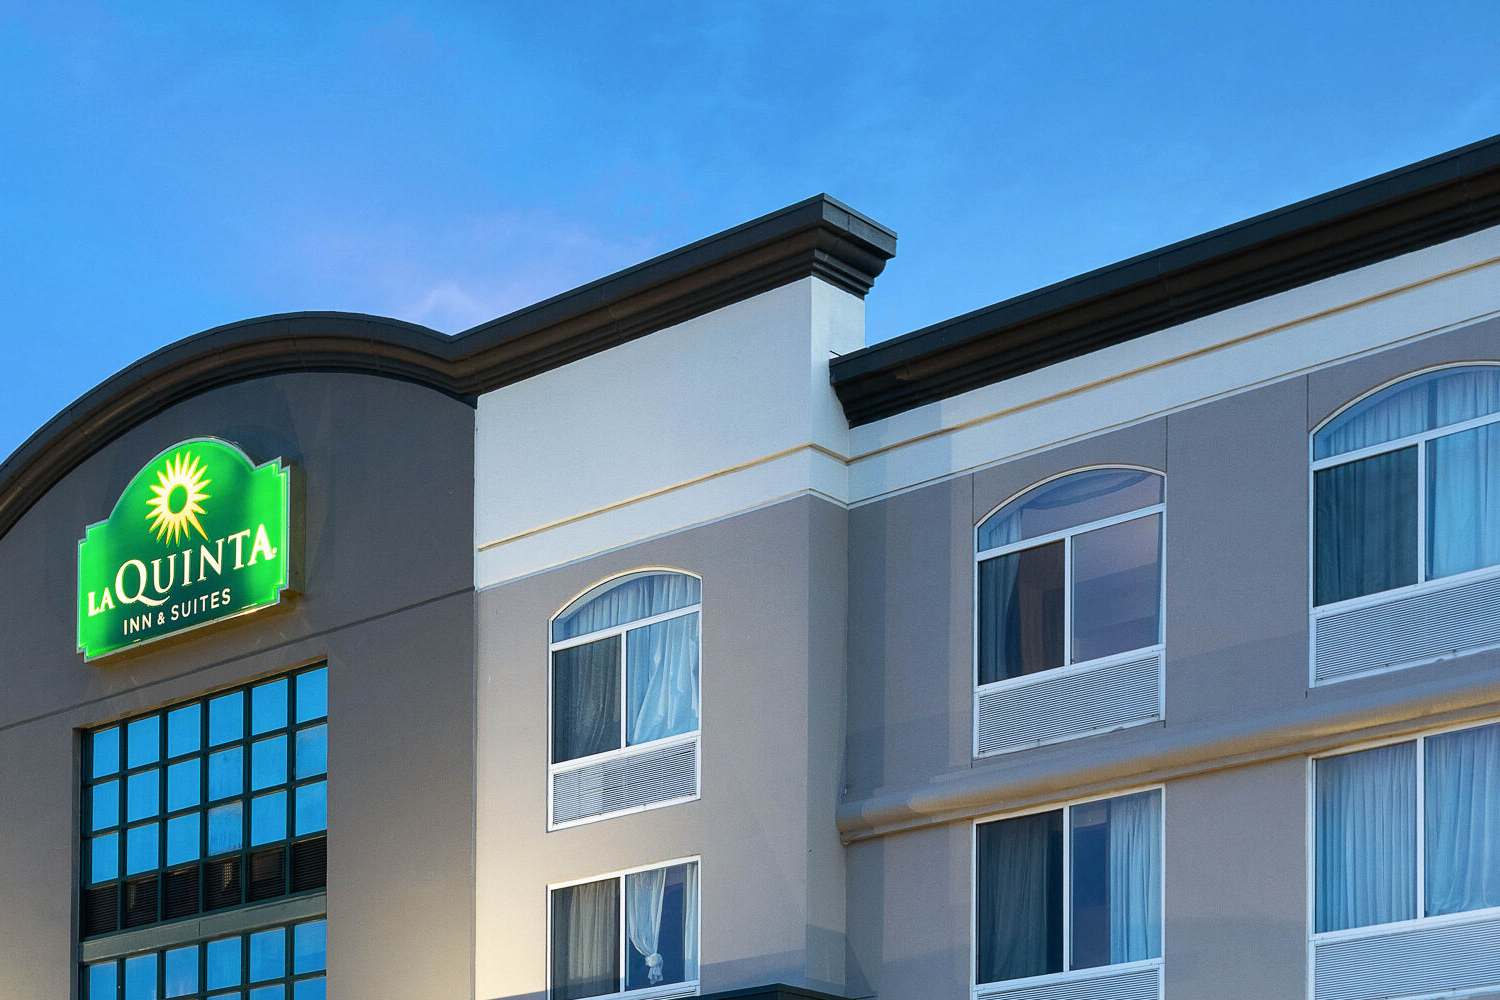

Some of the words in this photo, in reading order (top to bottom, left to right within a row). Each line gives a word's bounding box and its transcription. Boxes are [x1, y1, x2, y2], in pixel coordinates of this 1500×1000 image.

[87, 587, 115, 617] LA
[115, 523, 276, 607] QUINTA
[123, 612, 152, 636] INN
[157, 611, 165, 626] &
[170, 587, 231, 621] SUITES
